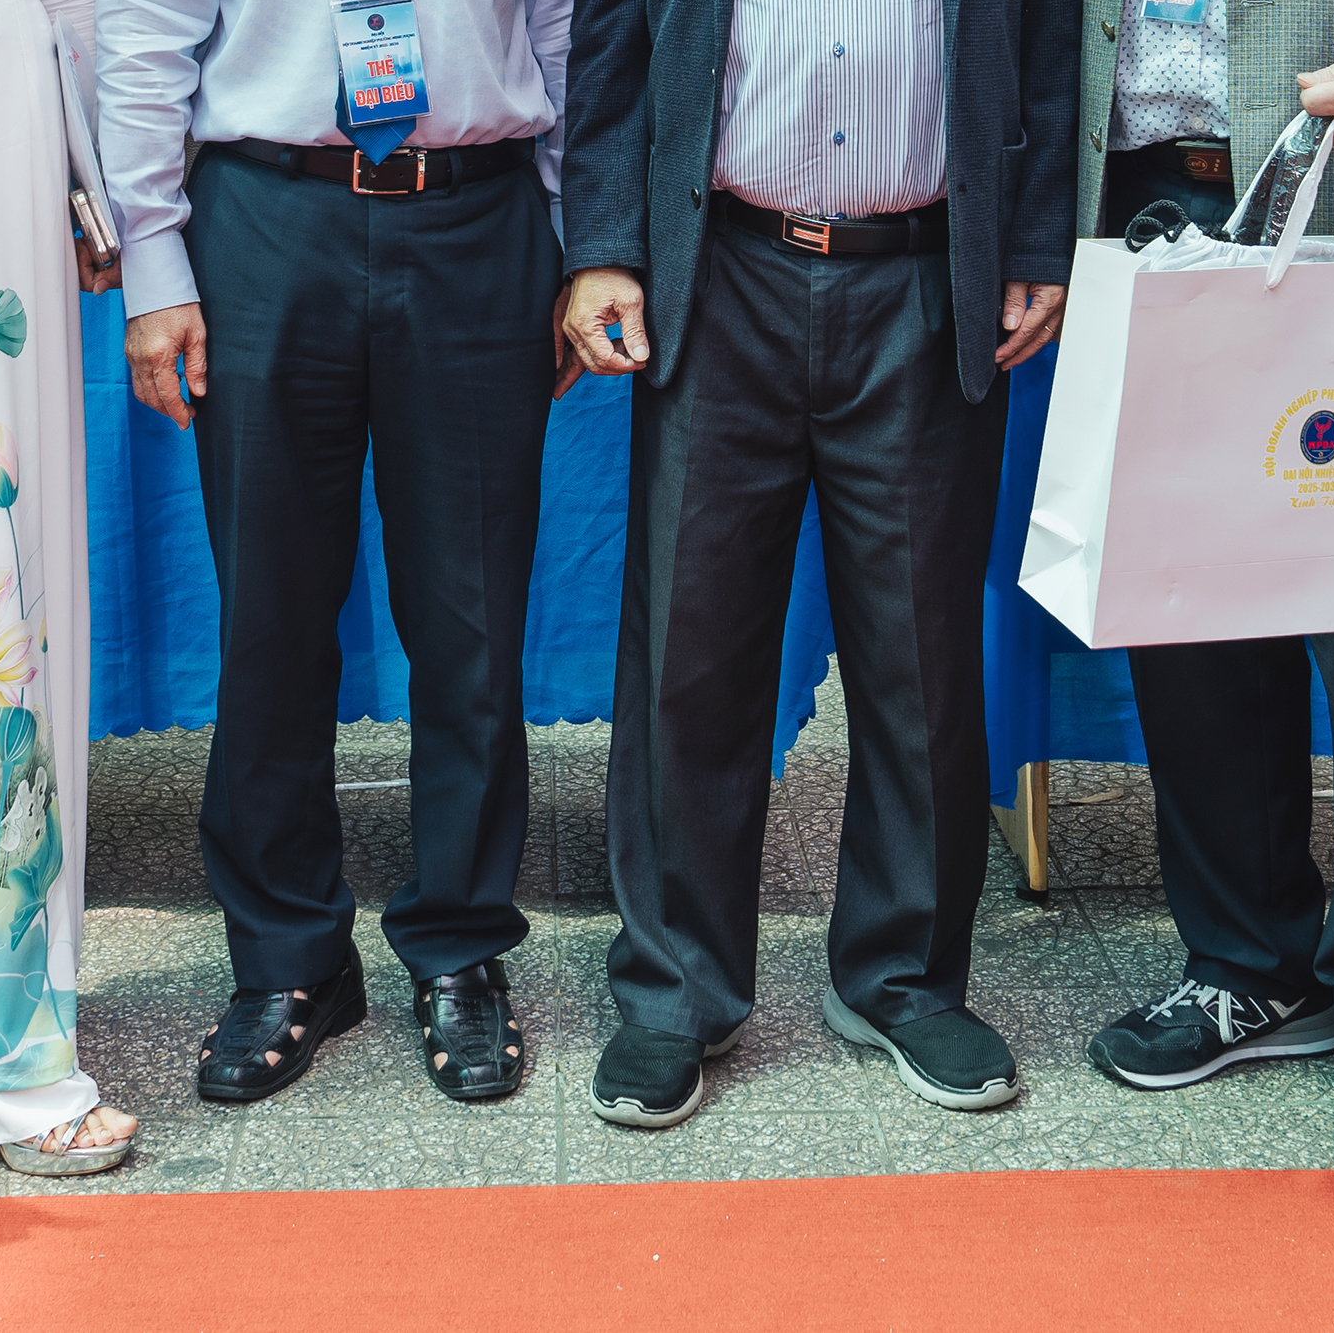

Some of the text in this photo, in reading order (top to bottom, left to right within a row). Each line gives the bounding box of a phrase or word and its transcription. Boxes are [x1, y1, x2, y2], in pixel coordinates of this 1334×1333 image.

[366, 54, 396, 78] THẺ
[354, 77, 415, 109] ĐẠI BIỂU
[1266, 414, 1289, 454] DOANH
[1284, 388, 1319, 417] NGHIỆP
[1283, 469, 1297, 482] ĐẠI
[1298, 466, 1313, 481] HỘI
